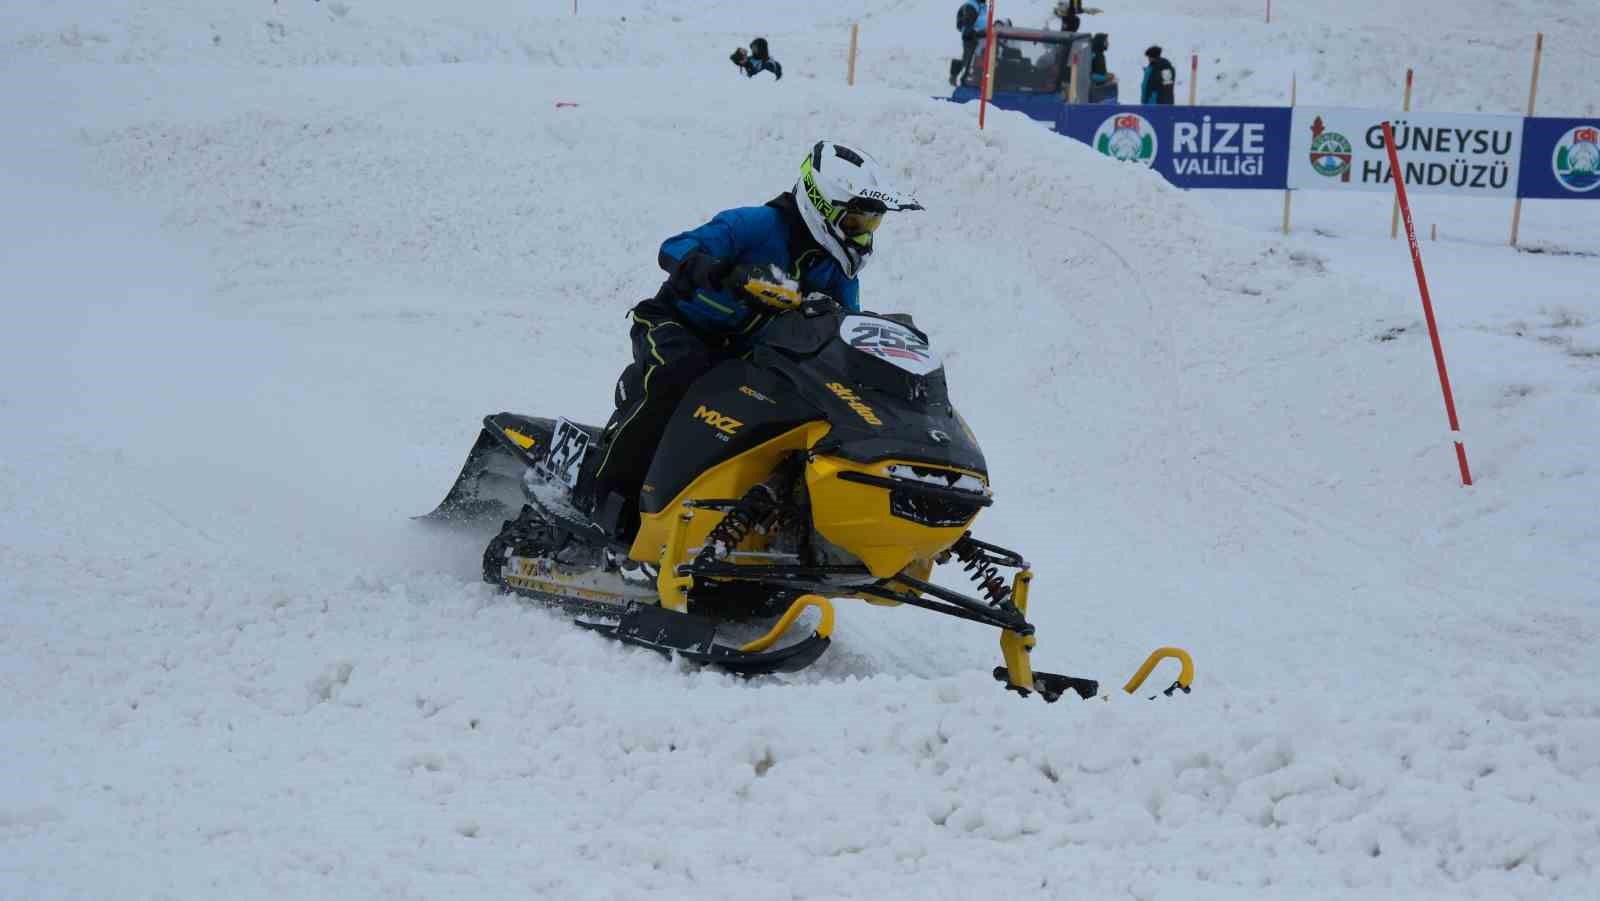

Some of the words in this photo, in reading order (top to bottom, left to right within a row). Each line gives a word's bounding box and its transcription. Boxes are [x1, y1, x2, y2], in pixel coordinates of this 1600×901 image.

[1173, 115, 1265, 154] RİZE
[1365, 120, 1513, 155] GÜNEYSU
[1173, 155, 1264, 176] VALİLİĞİ
[851, 326, 931, 359] 252
[693, 405, 744, 434] MXZ
[546, 421, 589, 481] 252
